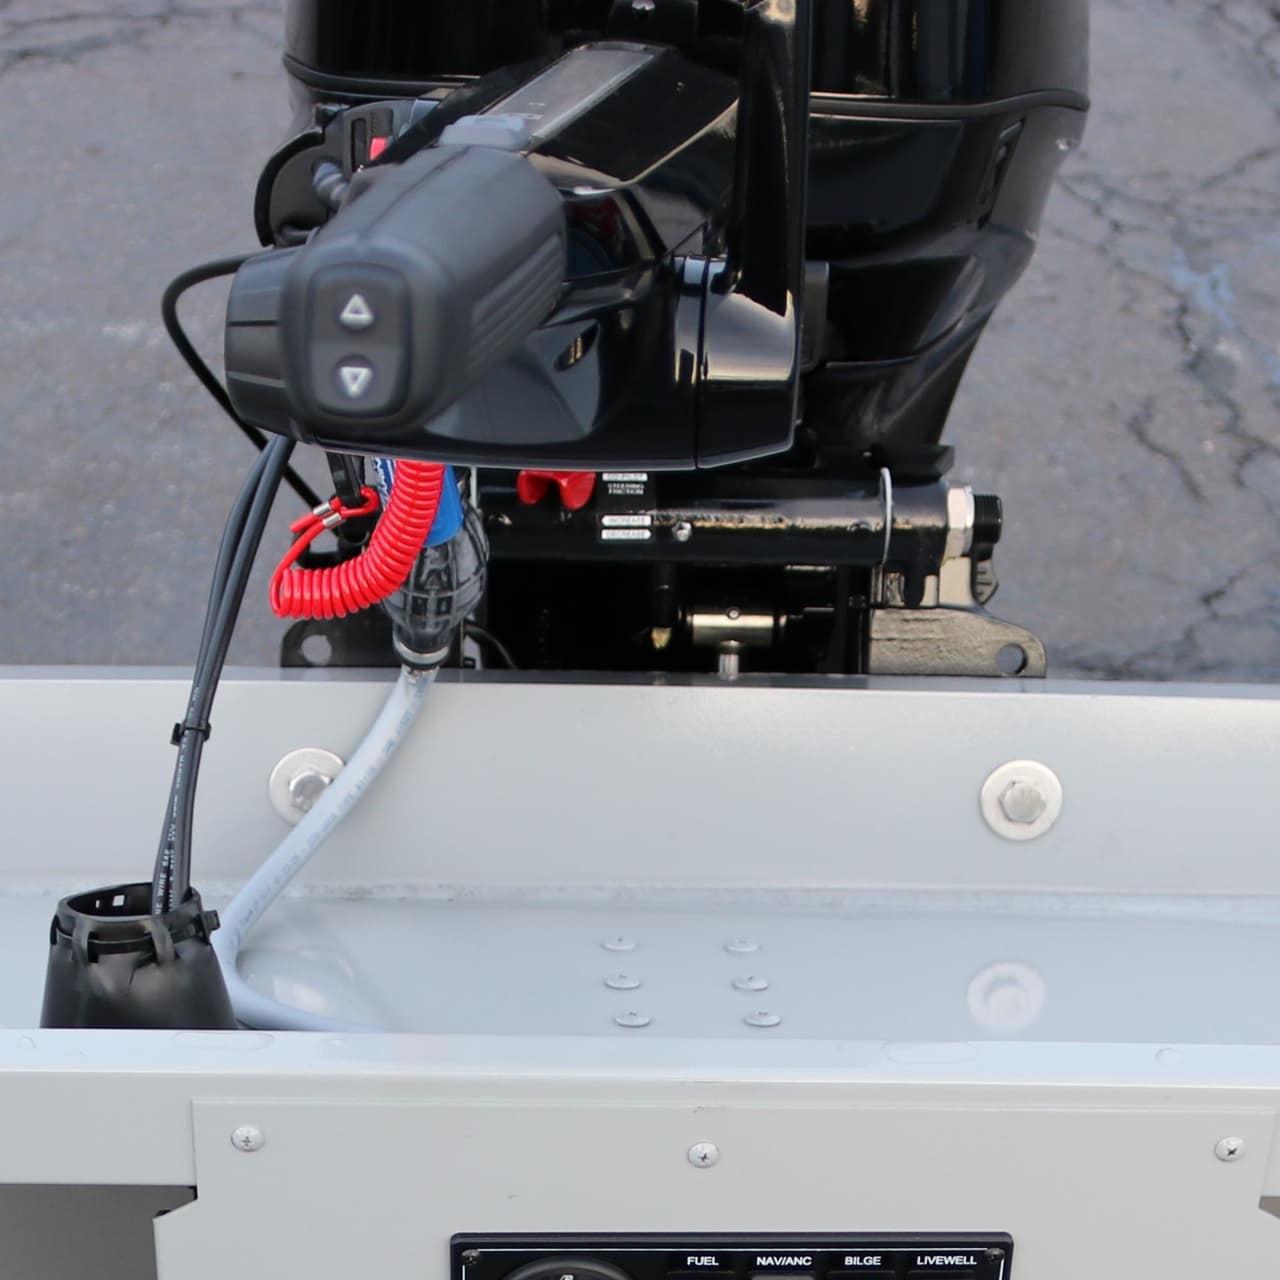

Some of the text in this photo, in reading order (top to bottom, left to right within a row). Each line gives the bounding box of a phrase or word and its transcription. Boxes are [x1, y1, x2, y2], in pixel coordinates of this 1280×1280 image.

[687, 1256, 719, 1266] FUEL
[756, 1256, 812, 1266] NAV/ANC
[844, 1256, 882, 1266] BILGE
[917, 1255, 977, 1265] LIVEWELL
